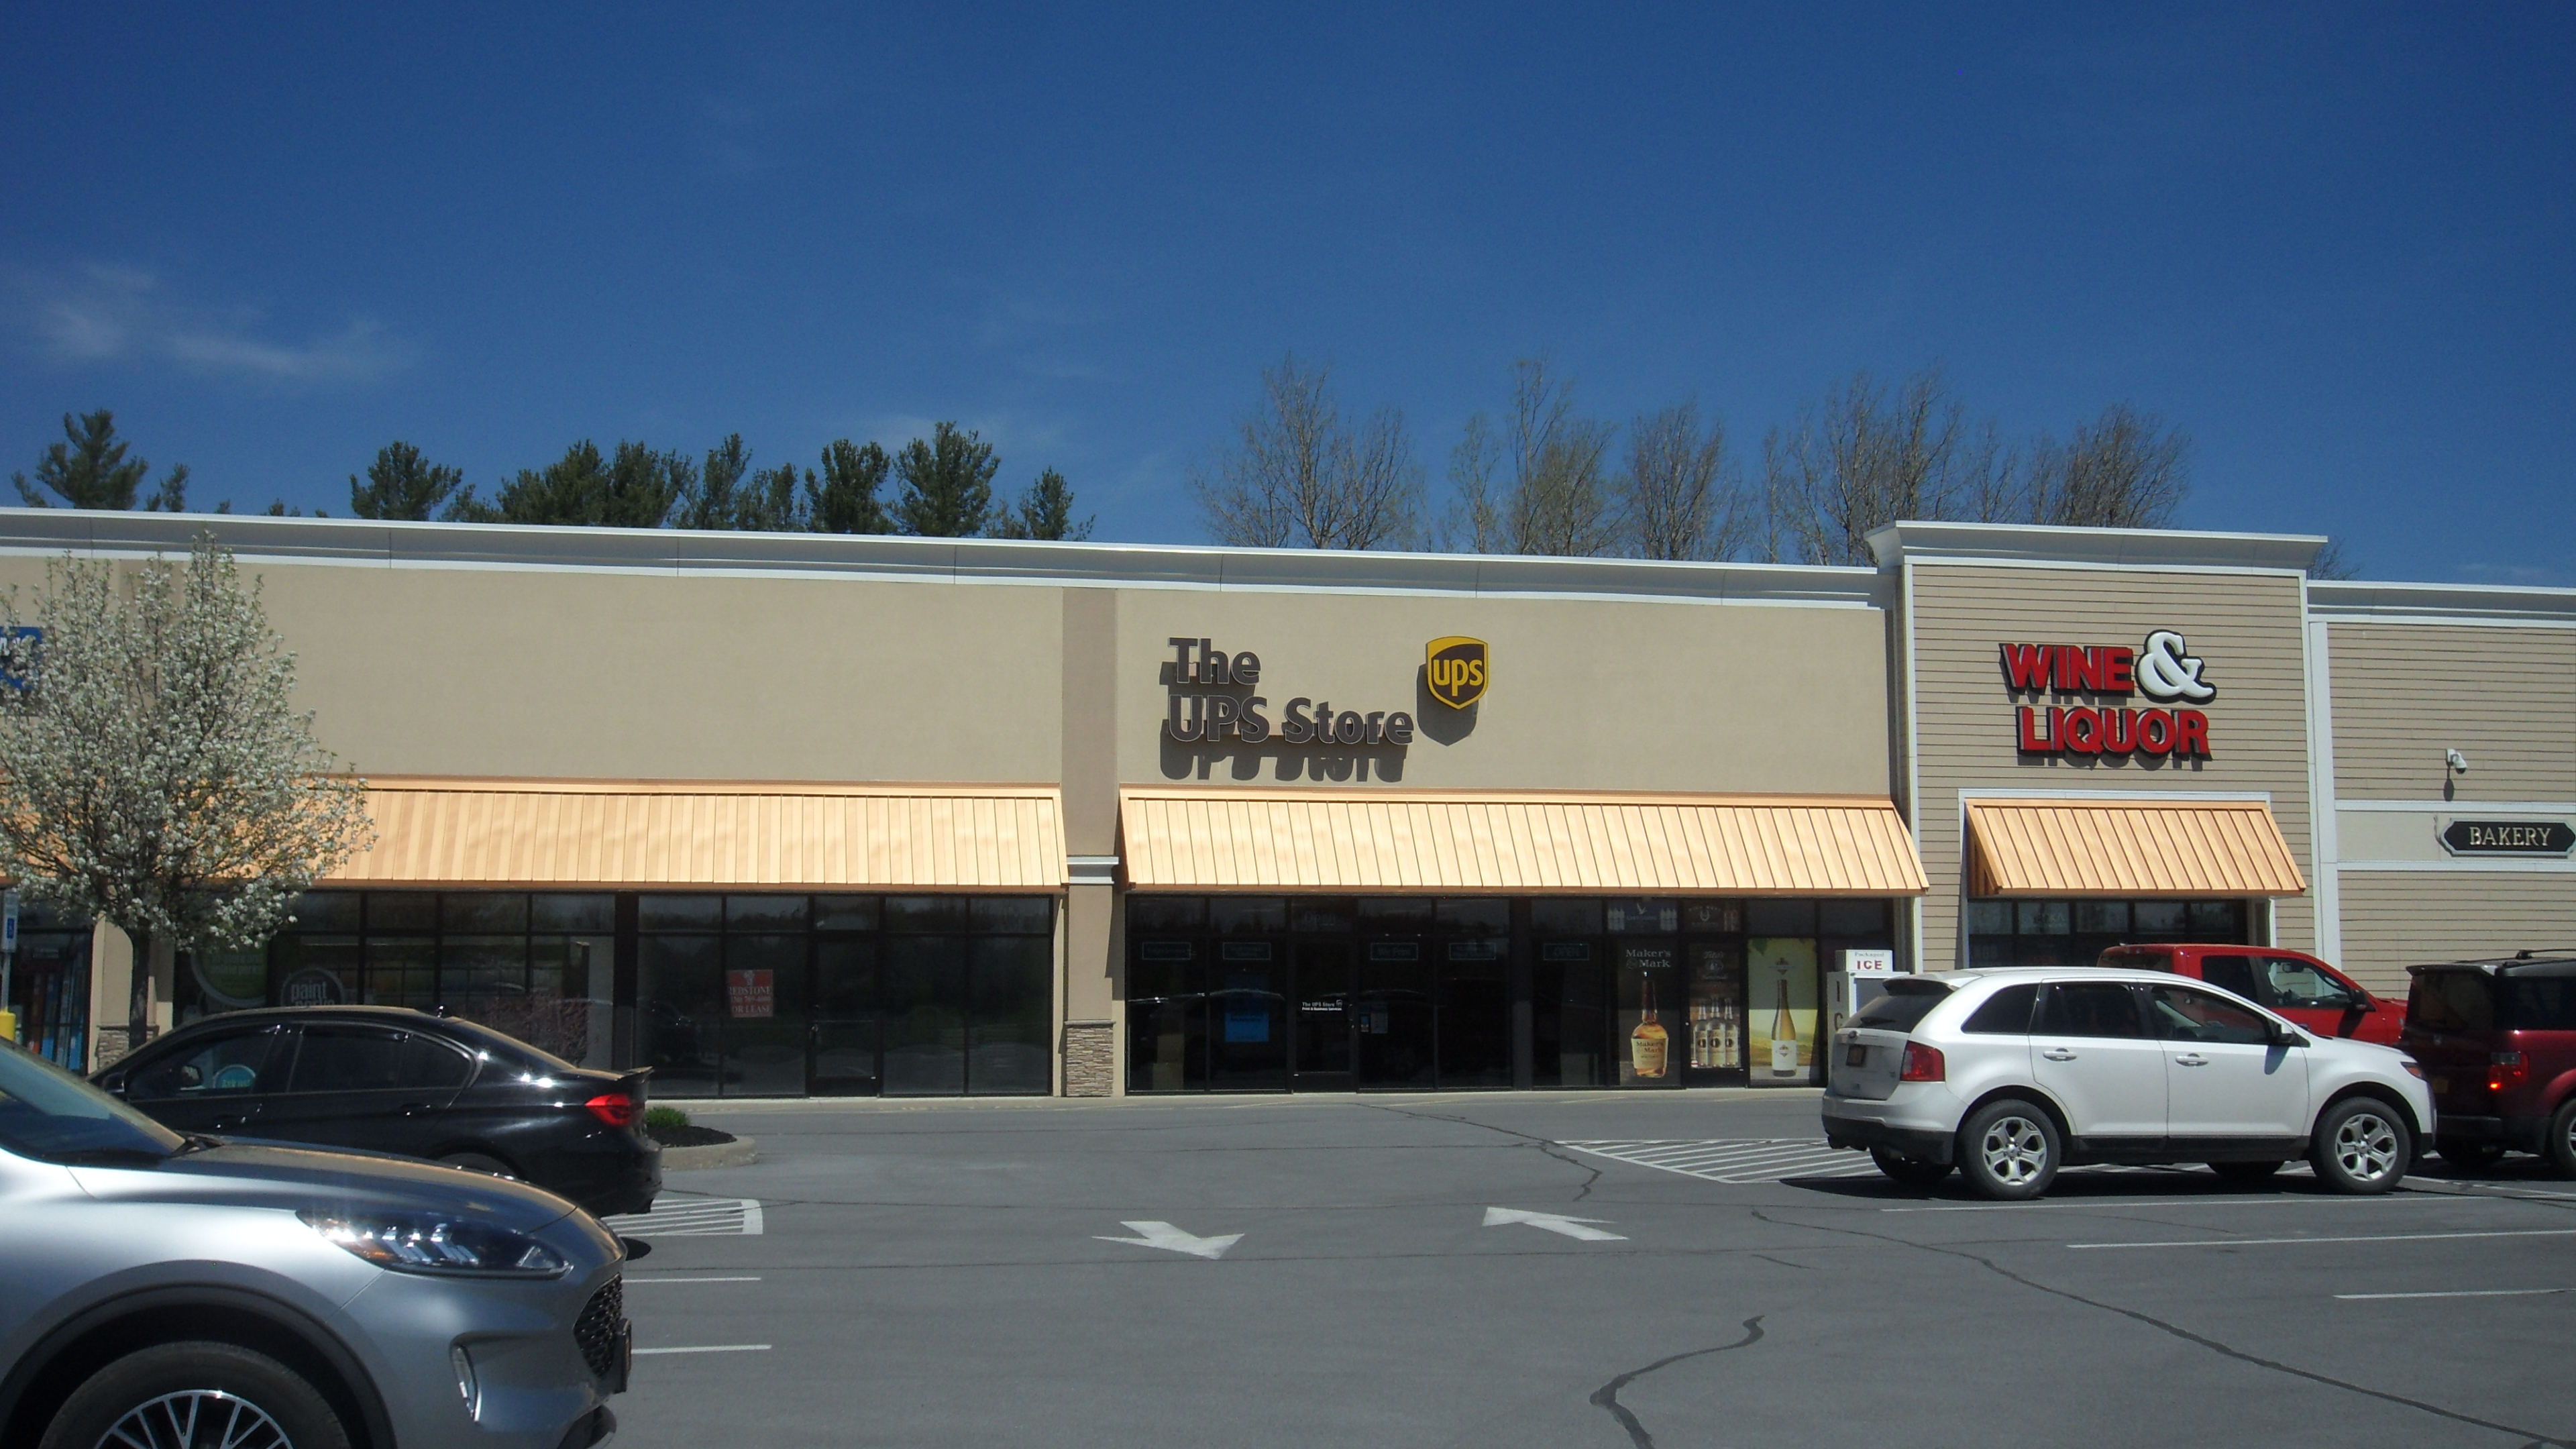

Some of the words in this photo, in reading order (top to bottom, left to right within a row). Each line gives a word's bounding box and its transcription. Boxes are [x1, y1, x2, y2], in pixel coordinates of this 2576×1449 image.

[1169, 637, 1261, 684] The
[2000, 643, 2135, 694] WINE
[2136, 630, 2216, 702] &
[1432, 658, 1484, 697] ups
[1169, 694, 1271, 743] UPS
[1284, 697, 1415, 745] Store
[2016, 706, 2212, 759] LIQUOR
[2469, 826, 2551, 846] BAKERY
[1554, 947, 1580, 957] OPEN
[1625, 949, 1672, 958] Maker's
[1639, 959, 1672, 968] Mark
[1857, 960, 1882, 970] ICE
[290, 980, 328, 1004] paint
[731, 1005, 743, 1013] OR
